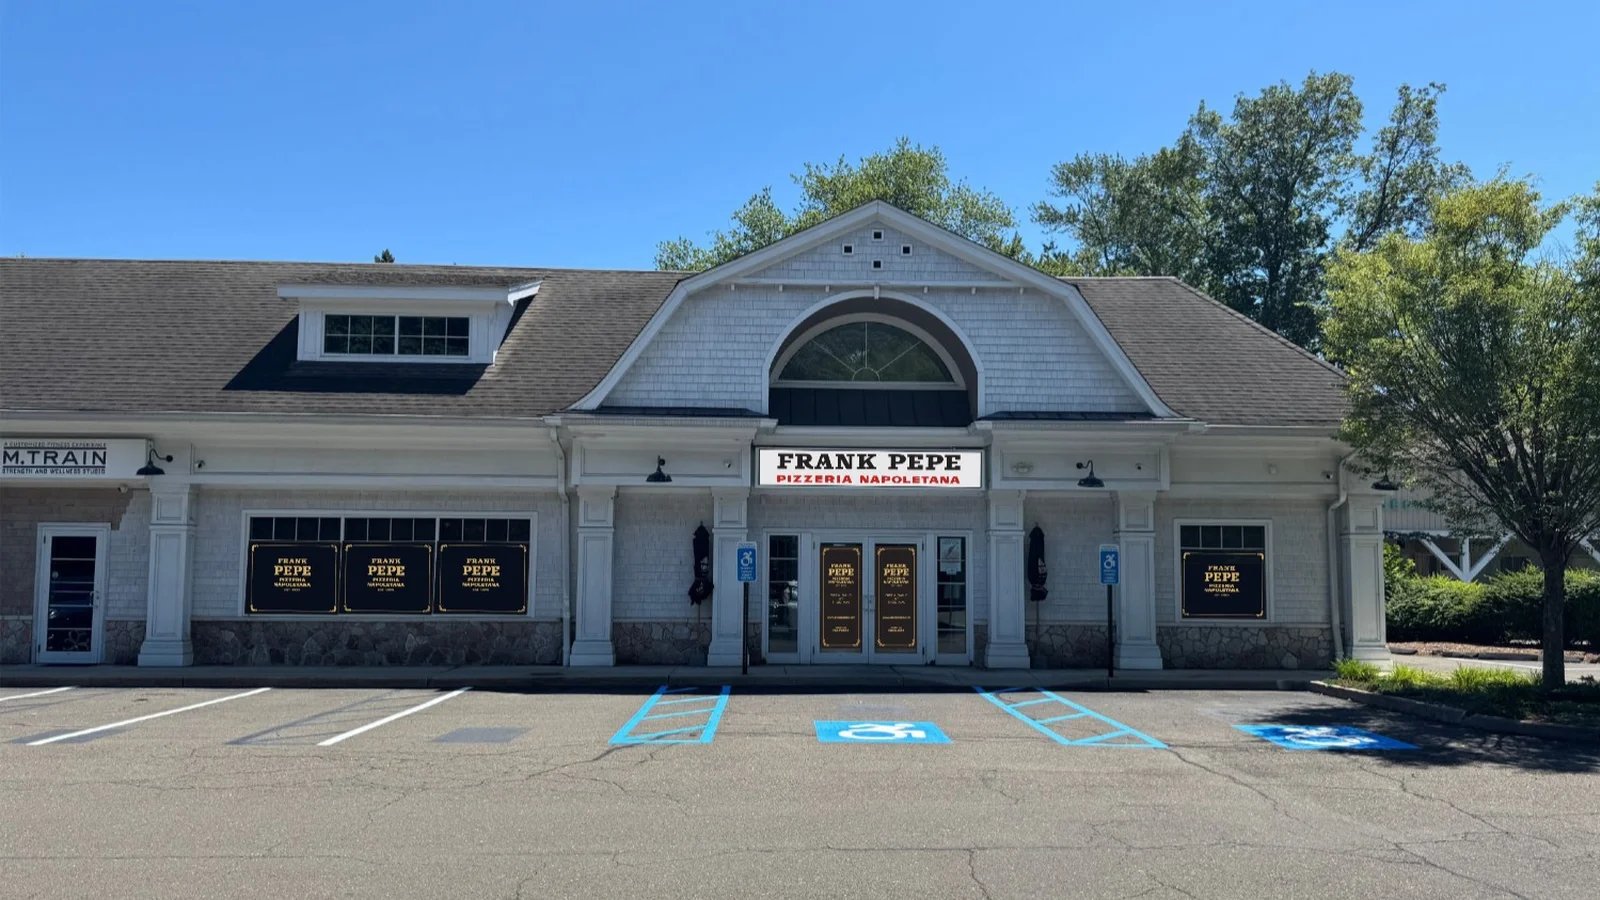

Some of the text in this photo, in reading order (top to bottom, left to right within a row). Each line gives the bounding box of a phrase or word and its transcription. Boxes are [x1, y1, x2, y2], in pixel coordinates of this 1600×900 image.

[3, 450, 107, 465] M.TRAIN
[777, 453, 961, 470] FRANK PEPE
[776, 474, 961, 485] PIZZERIA NAPOLETANA
[274, 565, 312, 576] PEPE
[367, 565, 406, 576] PEPE
[462, 565, 501, 576] PEPE
[828, 568, 855, 576] PEPE
[883, 568, 910, 576] PEPE
[1204, 572, 1240, 582] PEPE
